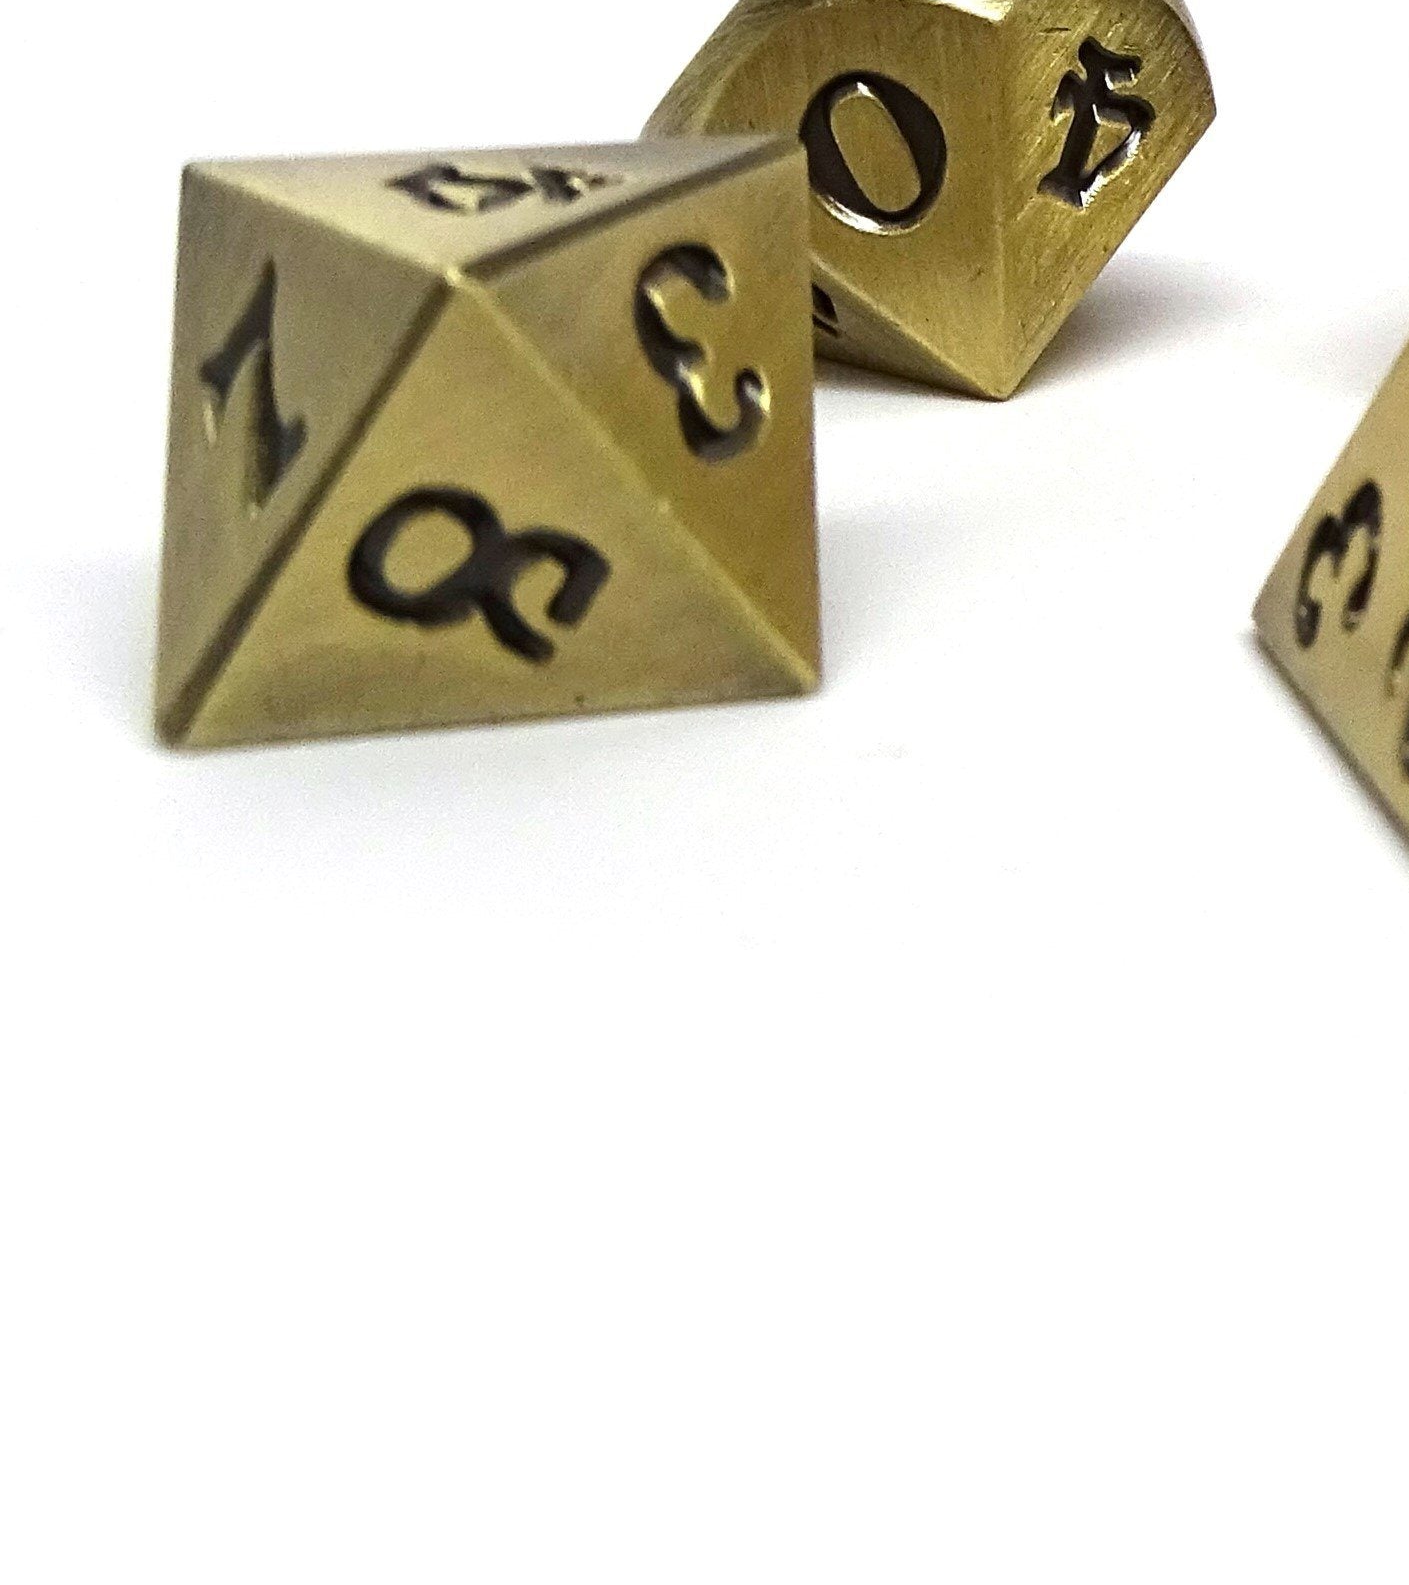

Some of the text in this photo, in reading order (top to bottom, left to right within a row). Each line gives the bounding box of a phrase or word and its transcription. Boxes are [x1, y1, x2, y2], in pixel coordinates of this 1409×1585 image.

[800, 70, 948, 236] 0
[1037, 33, 1156, 211] 4
[634, 242, 772, 464] 3
[347, 482, 612, 665] 8
[1294, 475, 1383, 649] 3
